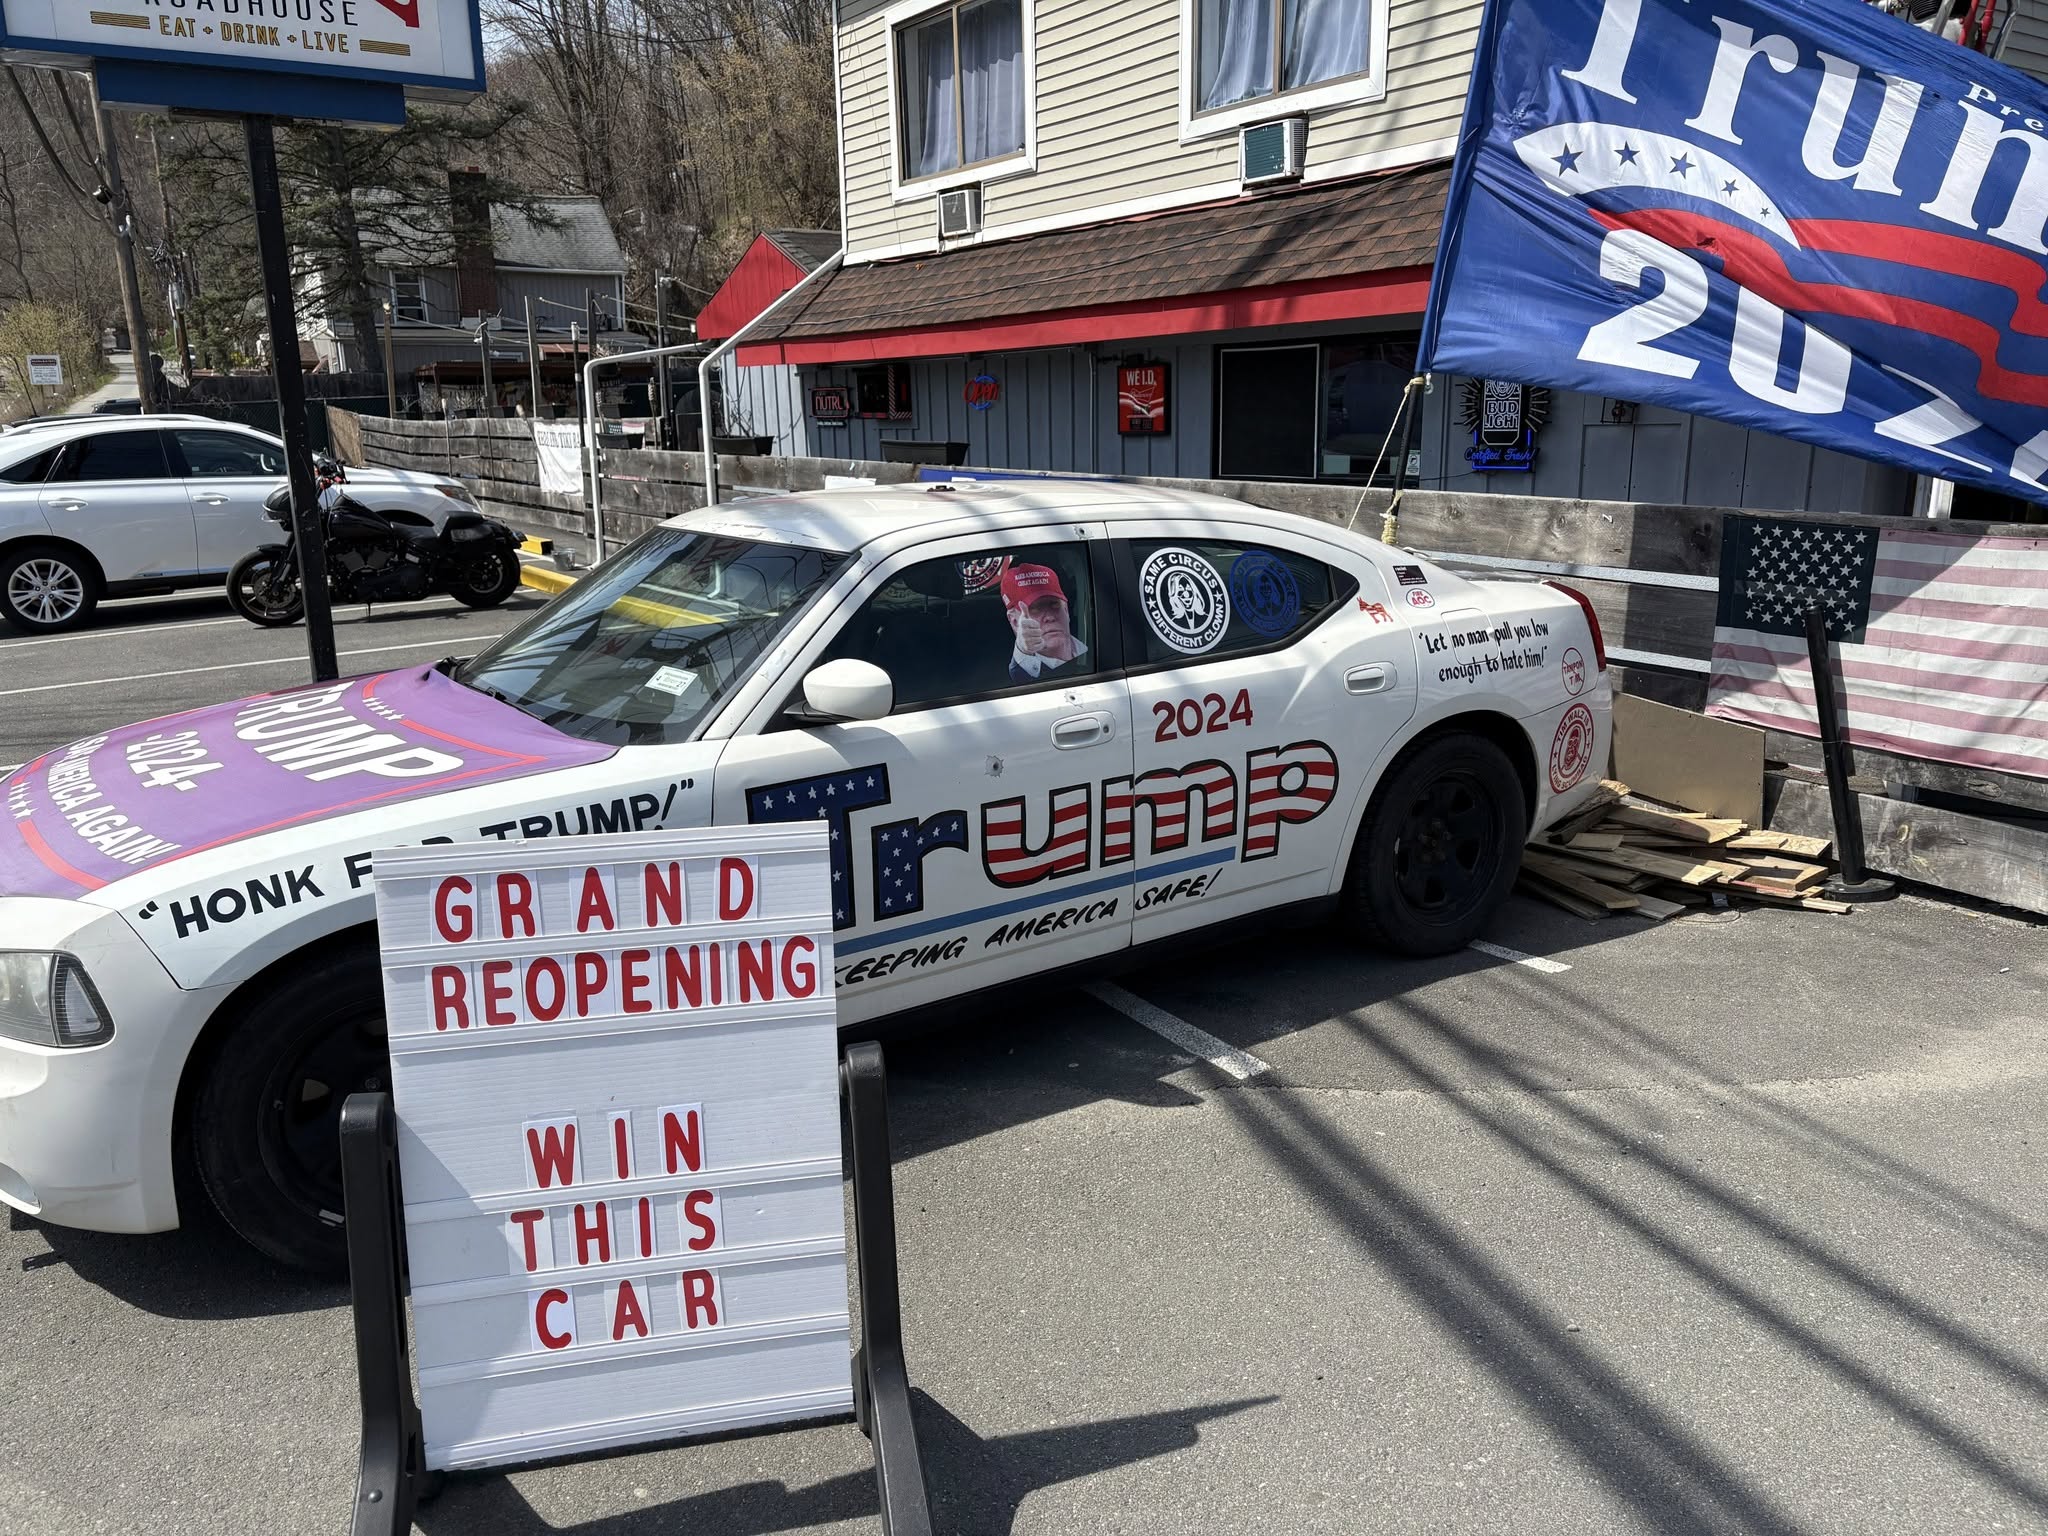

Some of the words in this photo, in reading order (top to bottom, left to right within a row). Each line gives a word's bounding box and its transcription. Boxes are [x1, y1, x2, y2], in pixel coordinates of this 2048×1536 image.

[145, 0, 358, 26] DHOUSE
[159, 15, 196, 38] EAT
[220, 22, 281, 47] DRINK
[302, 30, 350, 53] LIVE
[1126, 370, 1140, 386] WE
[1484, 414, 1519, 428] LIGHT
[1487, 400, 1519, 414] BUD
[1144, 557, 1167, 595] SAME
[1168, 553, 1218, 589] CIRCUS
[1411, 595, 1432, 606] AOC
[1152, 609, 1203, 648] DIFFERENT
[1204, 602, 1224, 642] CLOWN
[1452, 633, 1466, 649] no
[1466, 629, 1490, 645] man
[1494, 621, 1513, 647] pull
[1514, 625, 1532, 644] you
[1530, 617, 1549, 637] low
[1438, 656, 1482, 684] enough
[1484, 653, 1499, 672] to
[1500, 650, 1524, 671] hate
[233, 681, 464, 782] TRUMP
[1152, 688, 1253, 743] 2024
[1567, 709, 1585, 722] WALZ
[65, 805, 182, 865] AGAIN!
[745, 739, 1340, 928] Trump
[434, 857, 754, 943] GRAND
[984, 900, 1118, 950] AMERICA
[1135, 867, 1223, 912] SAFE!
[431, 935, 817, 1032] REOPENING
[526, 1110, 701, 1189] WIN
[510, 1190, 717, 1273] THIS
[535, 1269, 718, 1350] CAR
